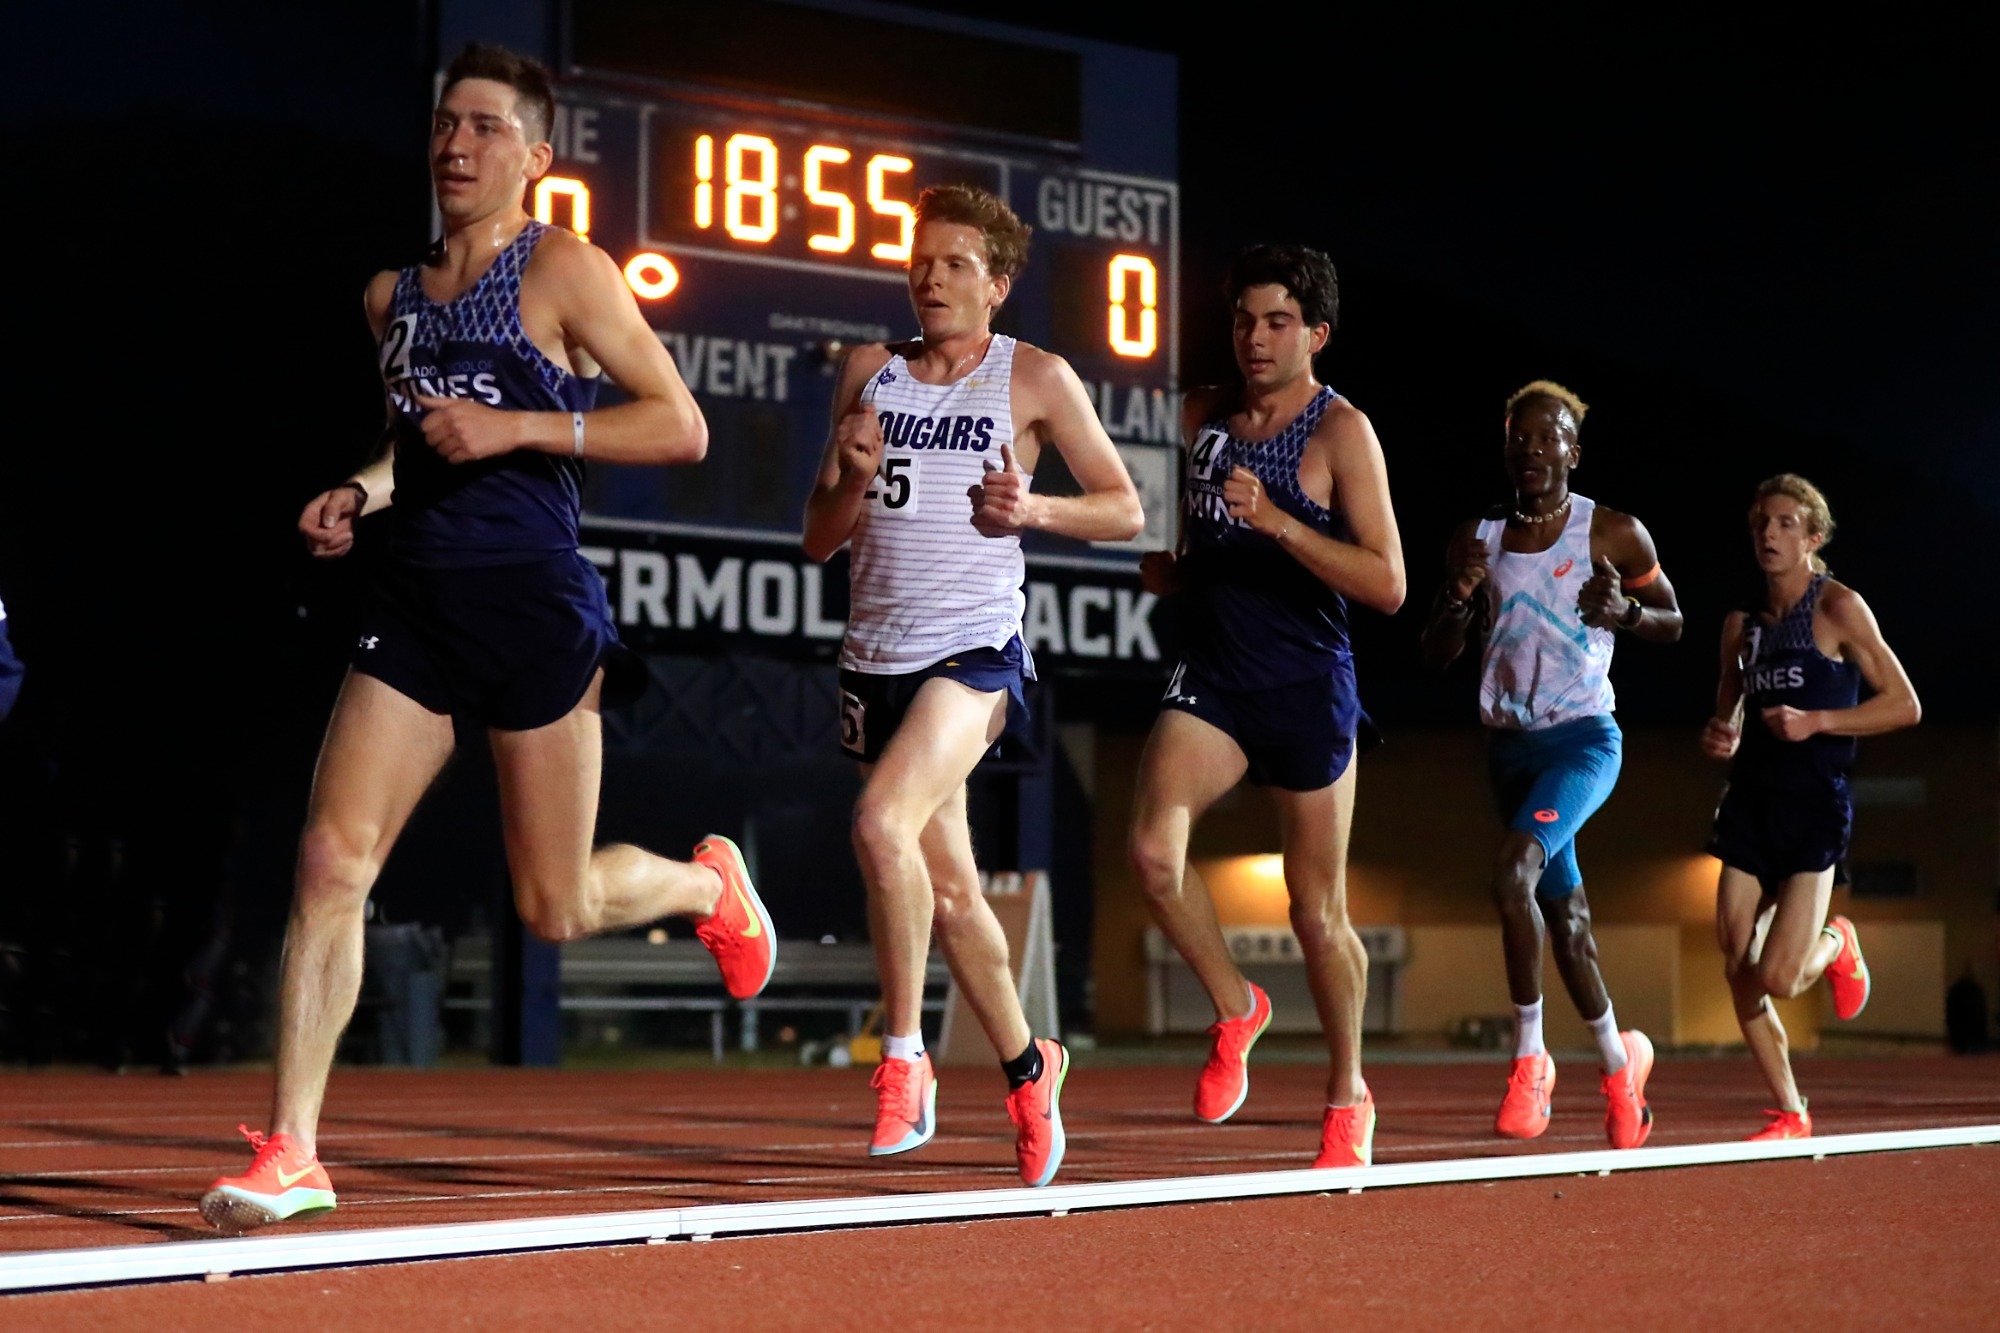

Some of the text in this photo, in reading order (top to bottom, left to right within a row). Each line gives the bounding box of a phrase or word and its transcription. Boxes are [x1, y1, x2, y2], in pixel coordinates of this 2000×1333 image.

[1038, 178, 1167, 244] GUEST
[1108, 254, 1158, 357] 0
[386, 321, 407, 375] 2
[879, 411, 994, 452] OUGARS
[1193, 434, 1220, 475] 4
[866, 459, 911, 508] 5
[1024, 580, 1162, 662] ACK
